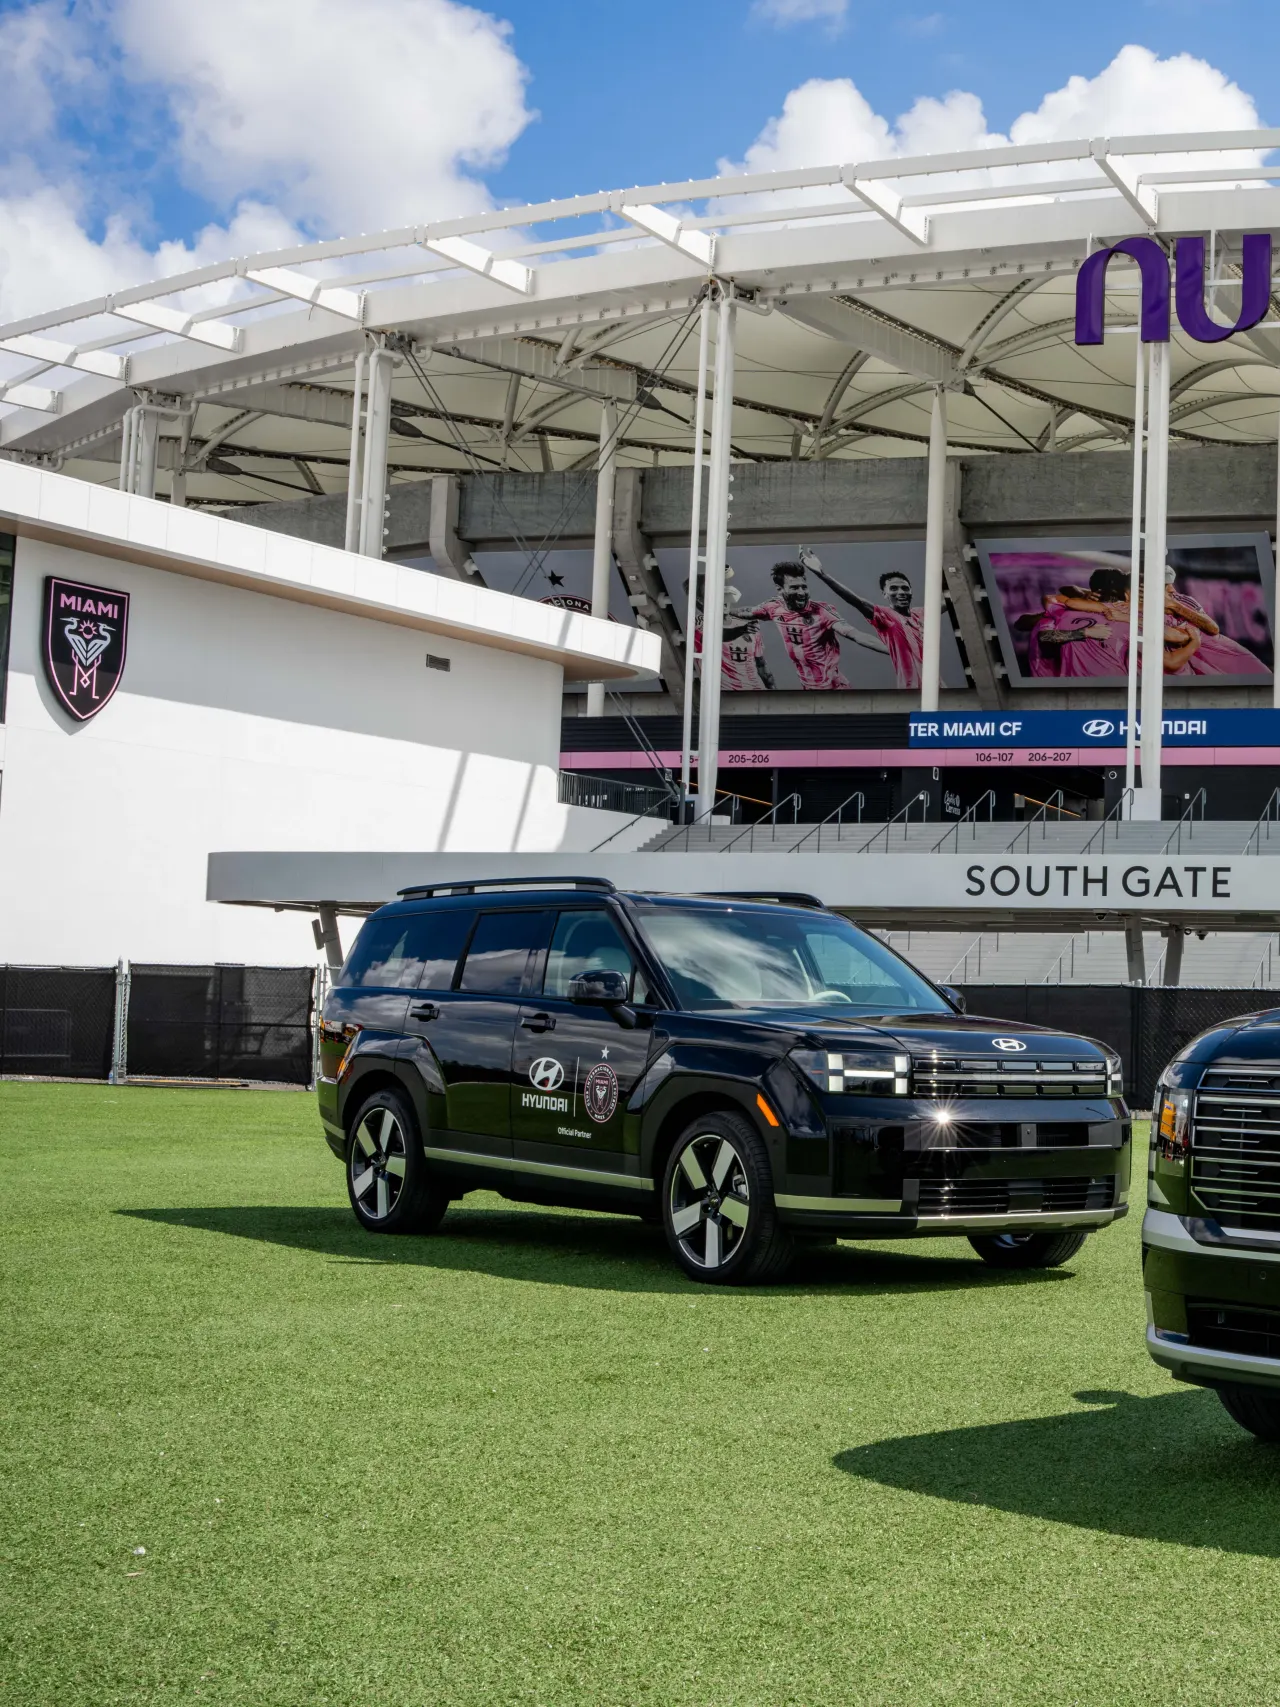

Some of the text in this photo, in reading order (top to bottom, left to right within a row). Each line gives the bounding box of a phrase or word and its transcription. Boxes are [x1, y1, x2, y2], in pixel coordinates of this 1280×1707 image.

[60, 593, 118, 619] MIAMI
[909, 721, 1022, 737] TER MIAMI CF
[1119, 720, 1207, 735] HYNDAI
[728, 755, 770, 764] 205-206
[975, 752, 1072, 762] 106-107 206-207
[965, 865, 1231, 898] SOUTH GATE
[522, 1093, 568, 1112] HYUNDAI
[557, 1127, 592, 1139] Official Partner
